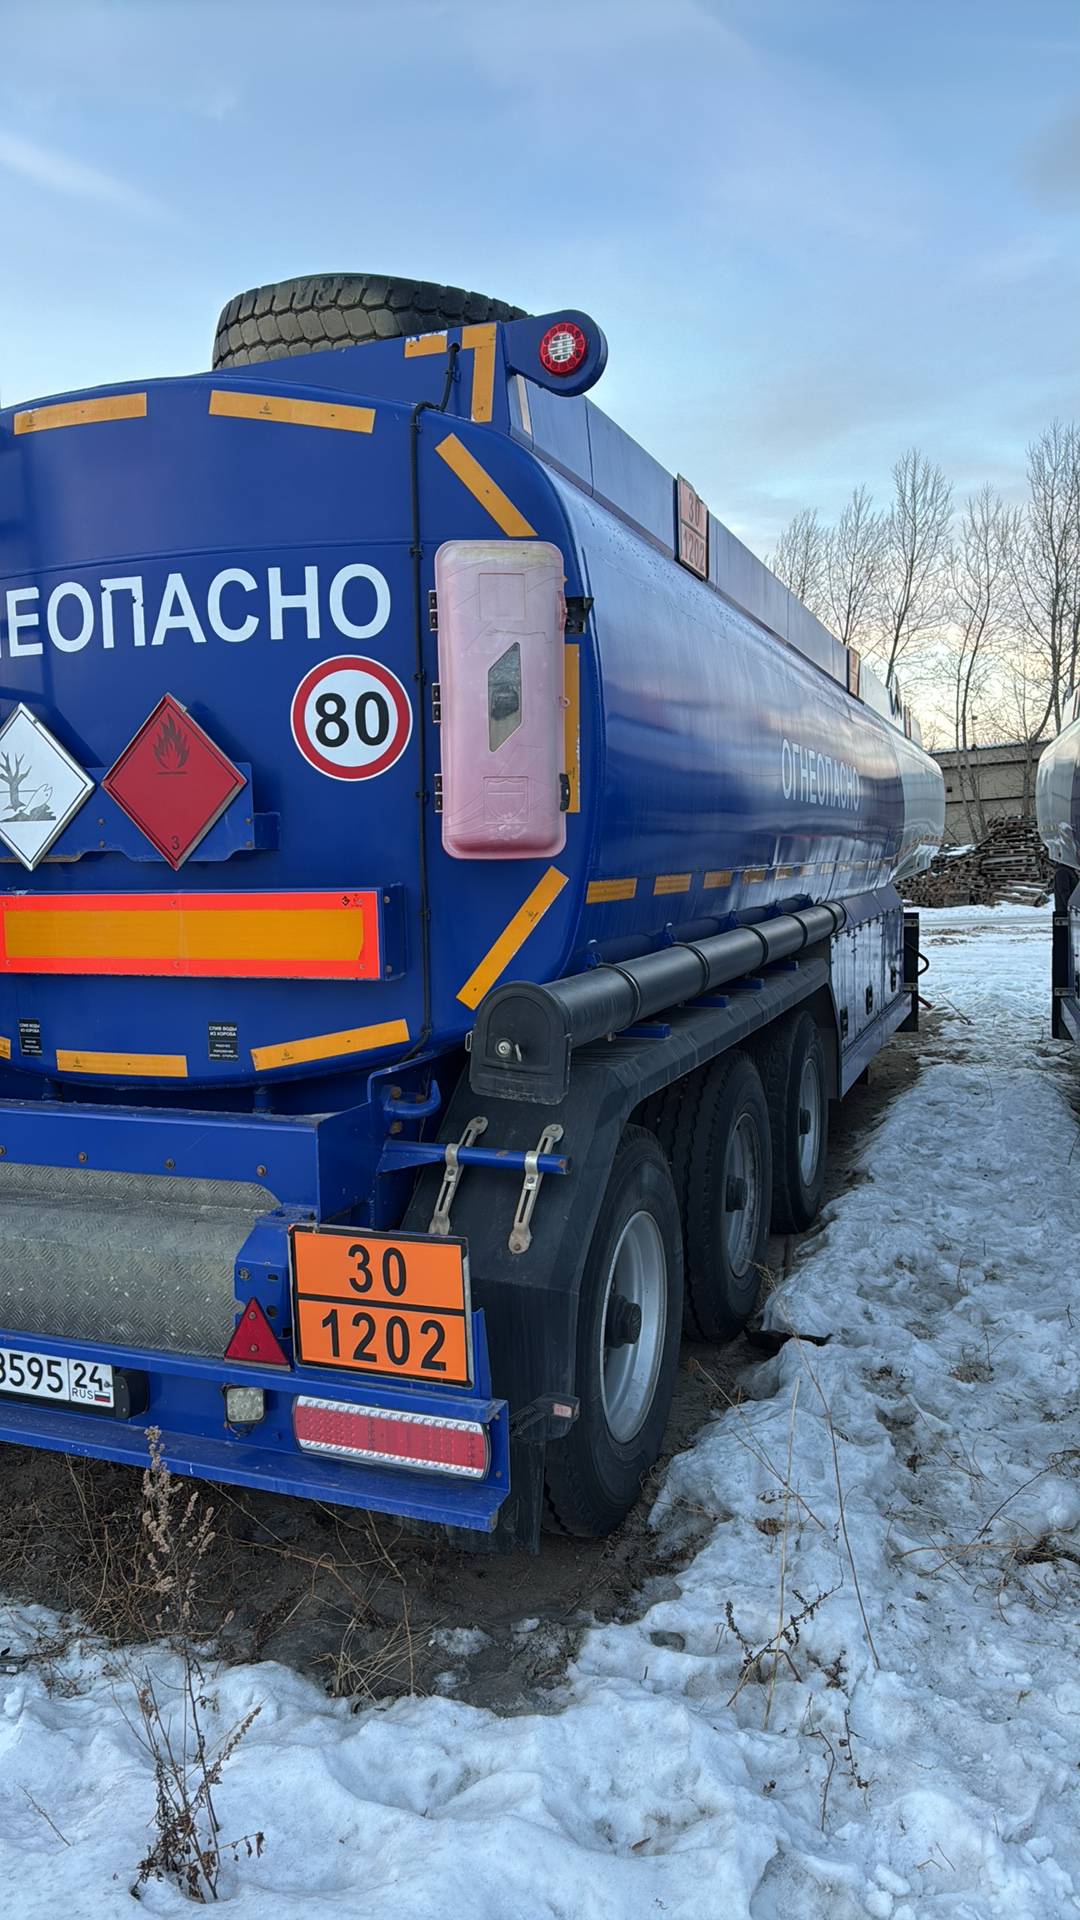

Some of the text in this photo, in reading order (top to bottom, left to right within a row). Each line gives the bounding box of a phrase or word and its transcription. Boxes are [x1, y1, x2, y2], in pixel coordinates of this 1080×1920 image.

[688, 493, 701, 528] 30
[683, 527, 705, 572] 1202
[0, 563, 391, 658] ЕОПАСНО
[315, 691, 390, 748] 80
[781, 738, 860, 811] ОГНЕОПАСНО
[171, 835, 180, 850] 3
[348, 1244, 407, 1297] 30
[321, 1309, 447, 1371] 1202
[71, 1387, 95, 1400] RUS
[73, 1362, 103, 1391] 24
